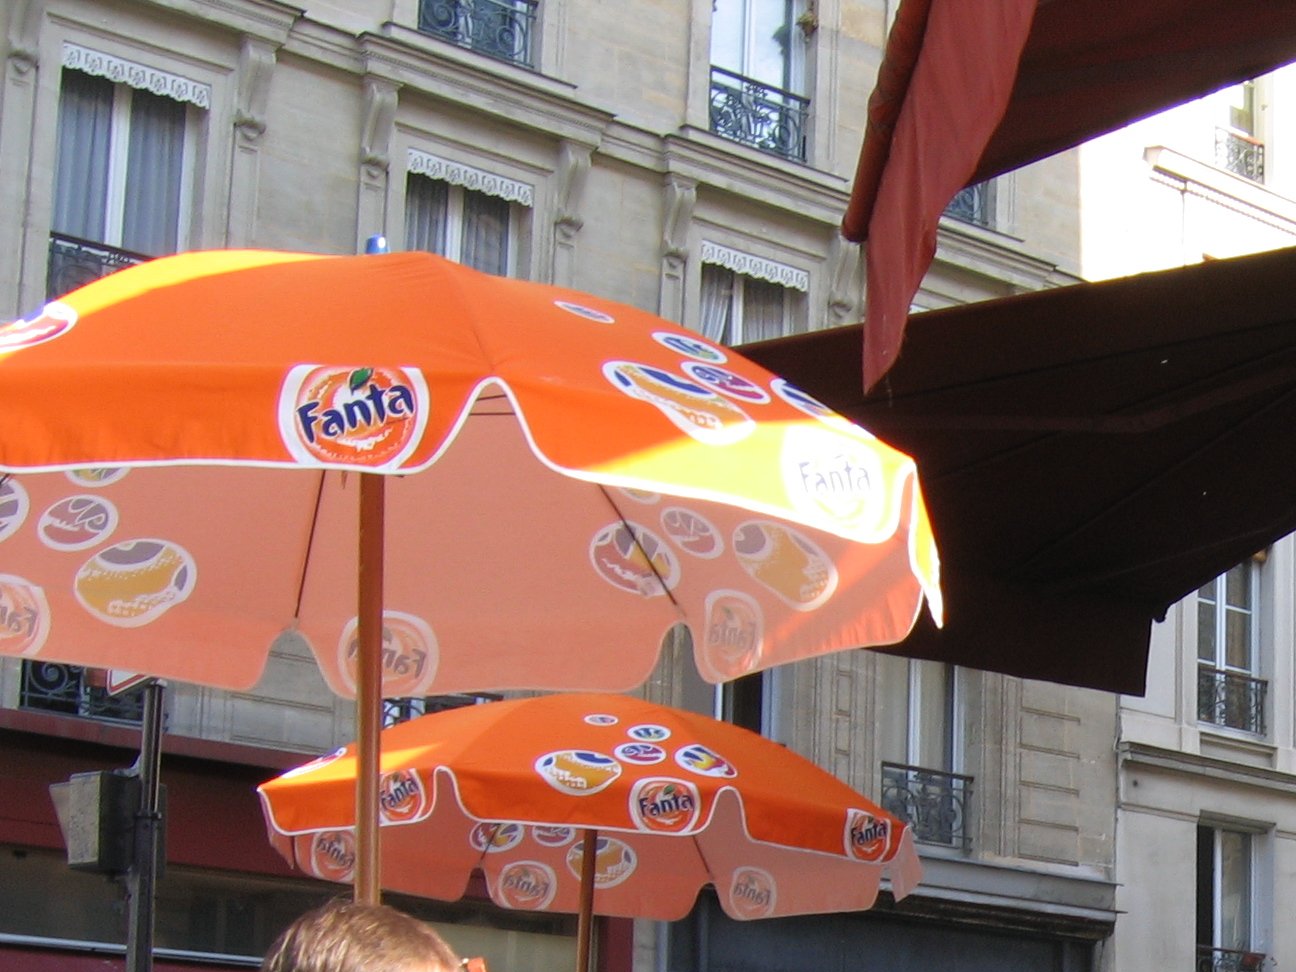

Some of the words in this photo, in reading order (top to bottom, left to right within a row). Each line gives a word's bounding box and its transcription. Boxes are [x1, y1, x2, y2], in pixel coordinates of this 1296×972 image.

[296, 383, 414, 444] Fanta
[797, 460, 872, 493] Fanta
[380, 778, 420, 811] Fanta
[639, 794, 694, 817] Fanta
[851, 822, 887, 846] Fanta
